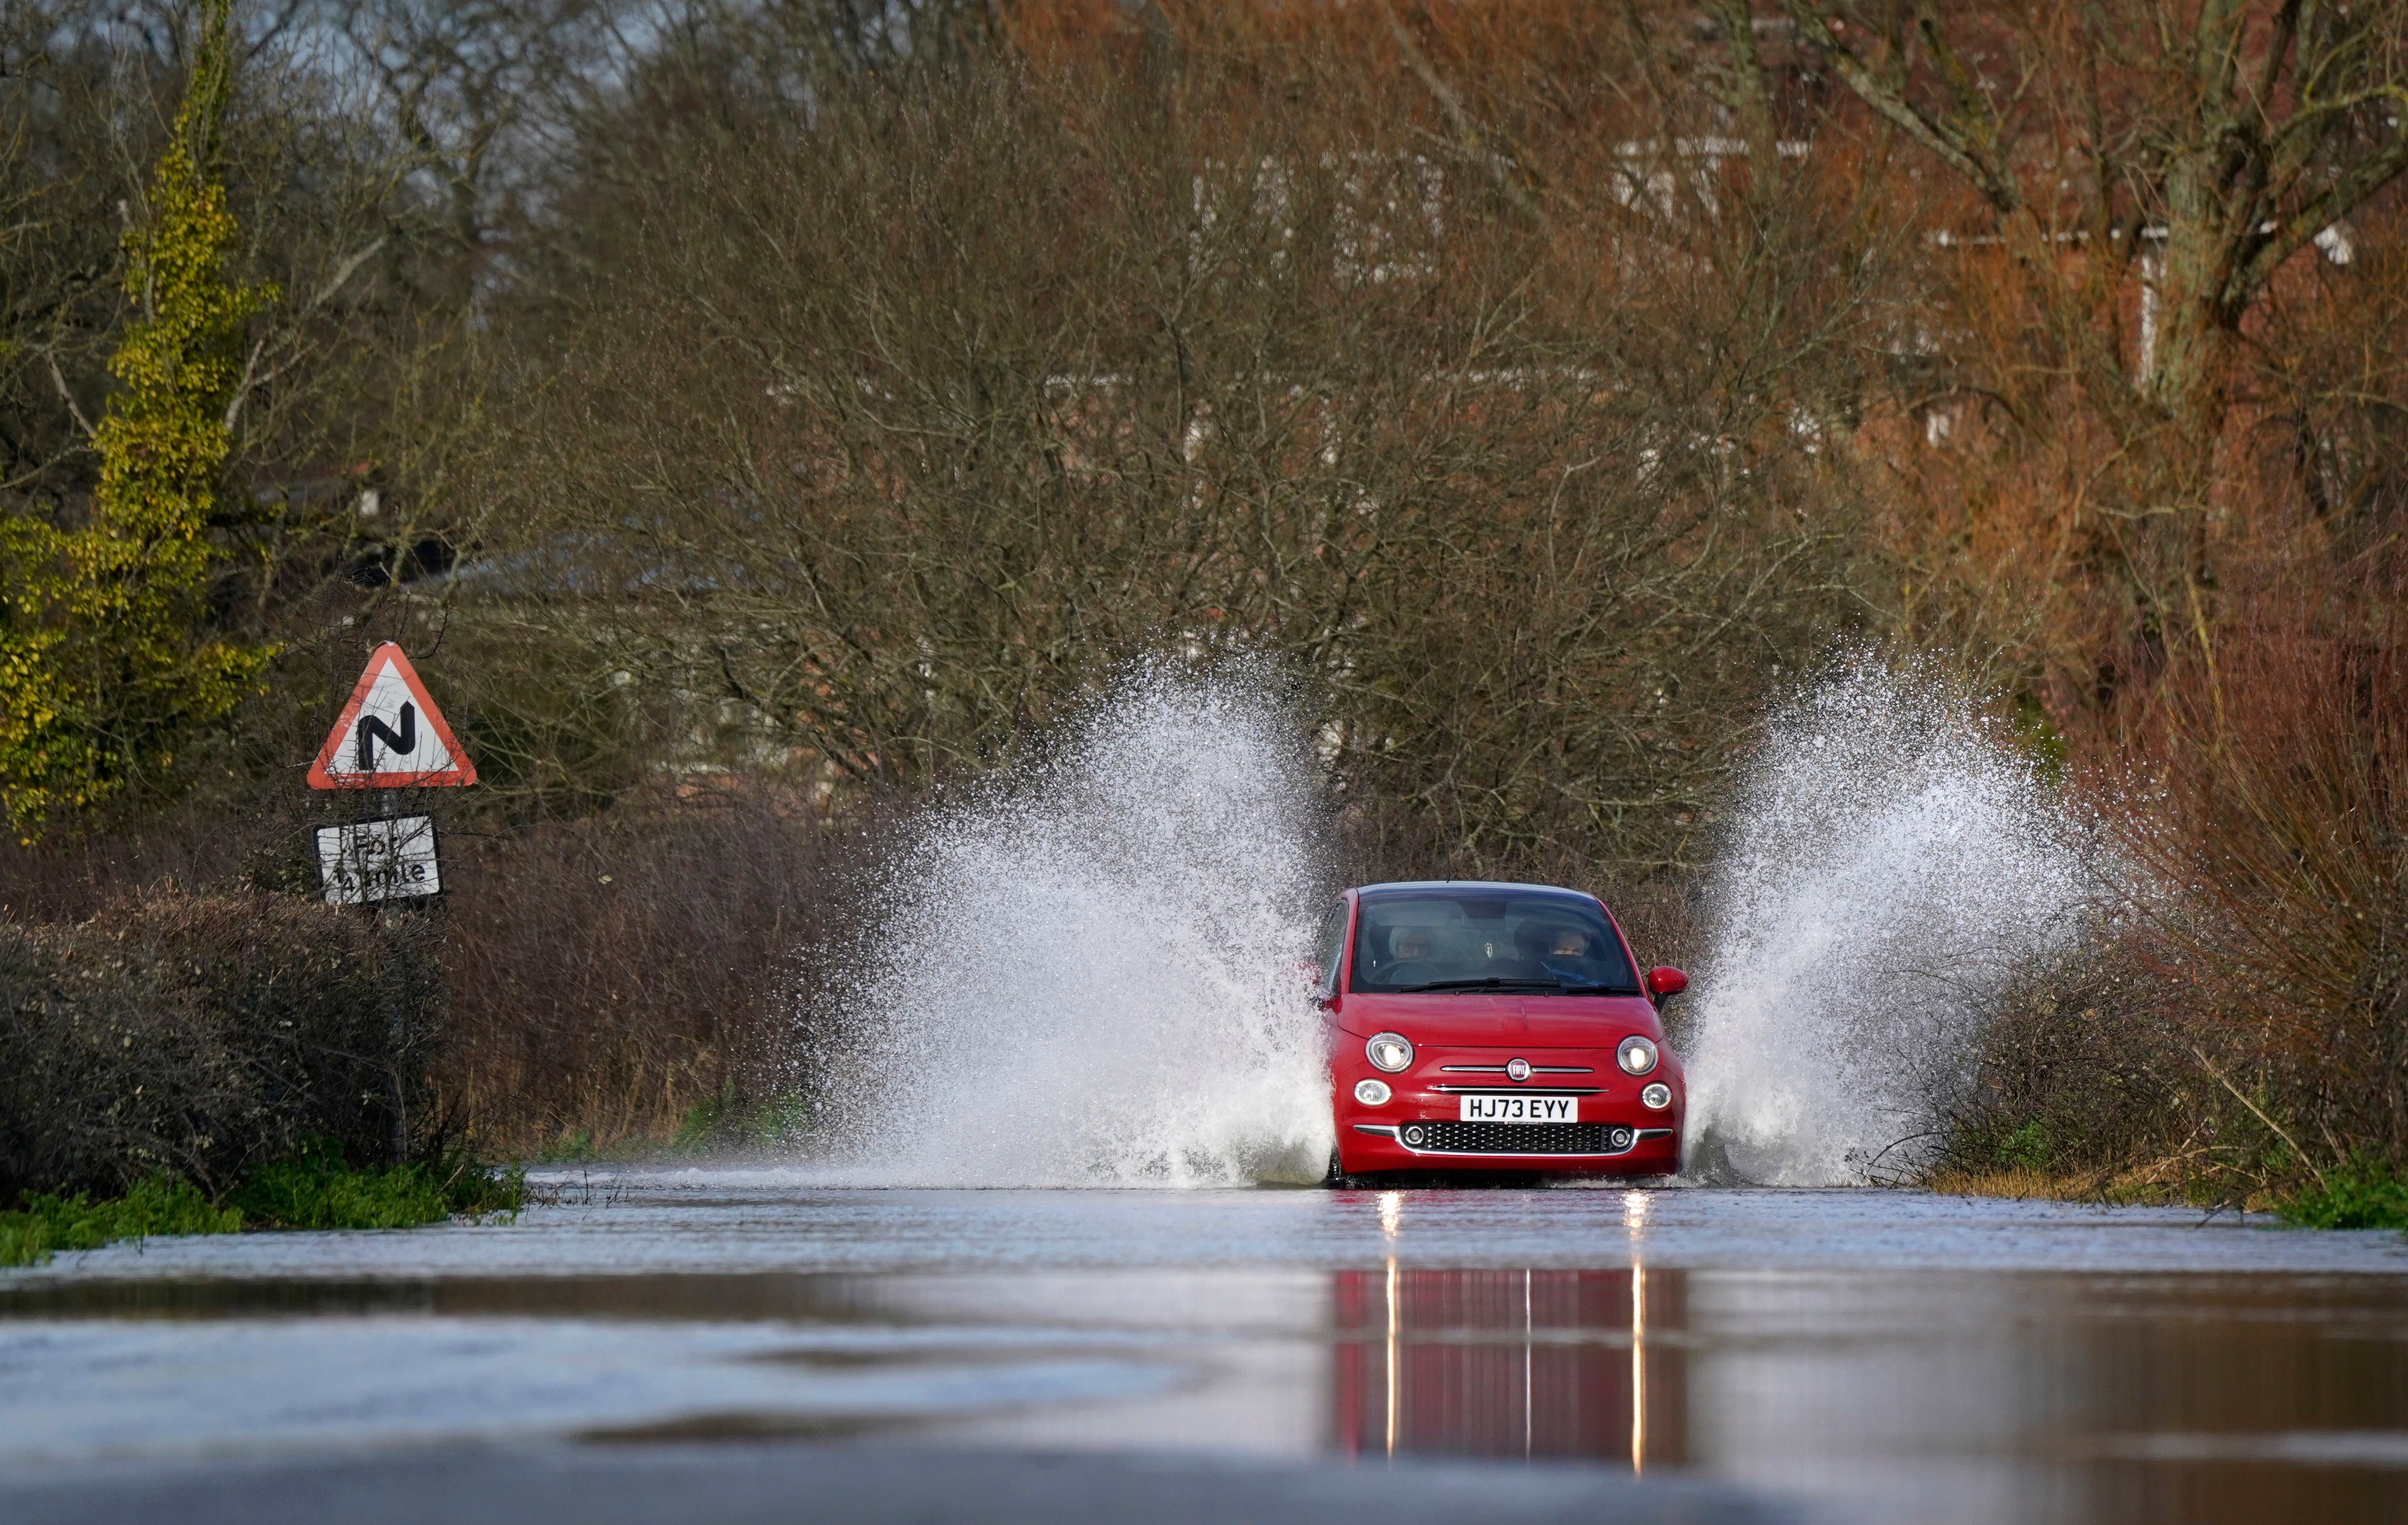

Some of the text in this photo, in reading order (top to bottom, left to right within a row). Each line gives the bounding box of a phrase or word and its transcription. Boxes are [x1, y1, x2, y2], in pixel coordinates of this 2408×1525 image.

[354, 834, 398, 857] For
[365, 856, 425, 887] mile
[1512, 1064, 1525, 1075] FIAT
[1469, 1099, 1569, 1119] HJ73 EYY
